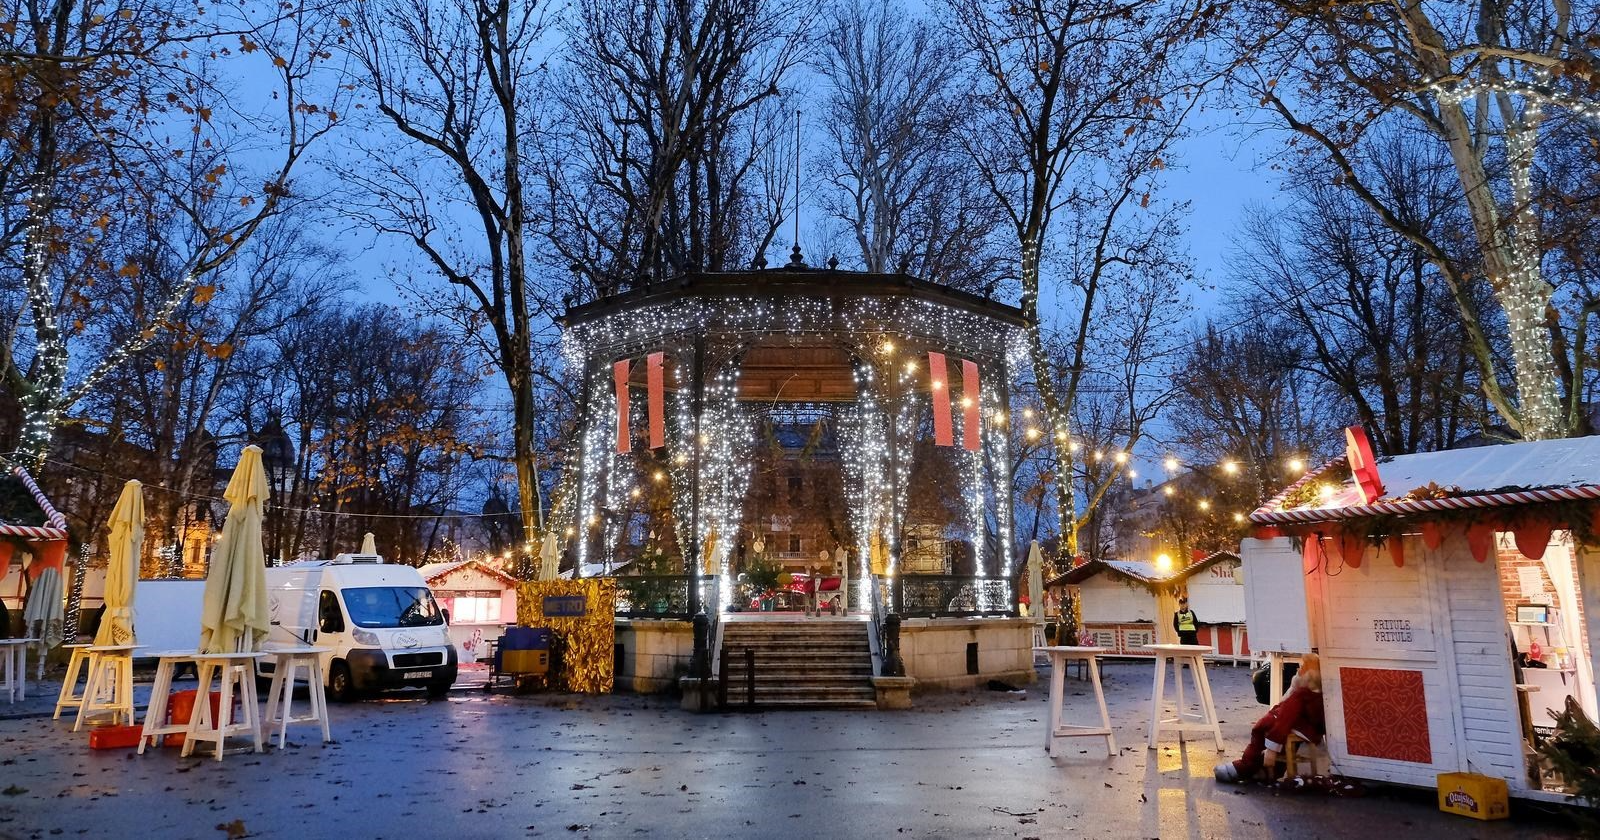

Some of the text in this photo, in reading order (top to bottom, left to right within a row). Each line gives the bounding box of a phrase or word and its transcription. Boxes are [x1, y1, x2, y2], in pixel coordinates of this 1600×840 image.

[544, 600, 583, 612] METRO
[1373, 619, 1411, 630] FRITULE
[1375, 631, 1412, 642] FRITULE
